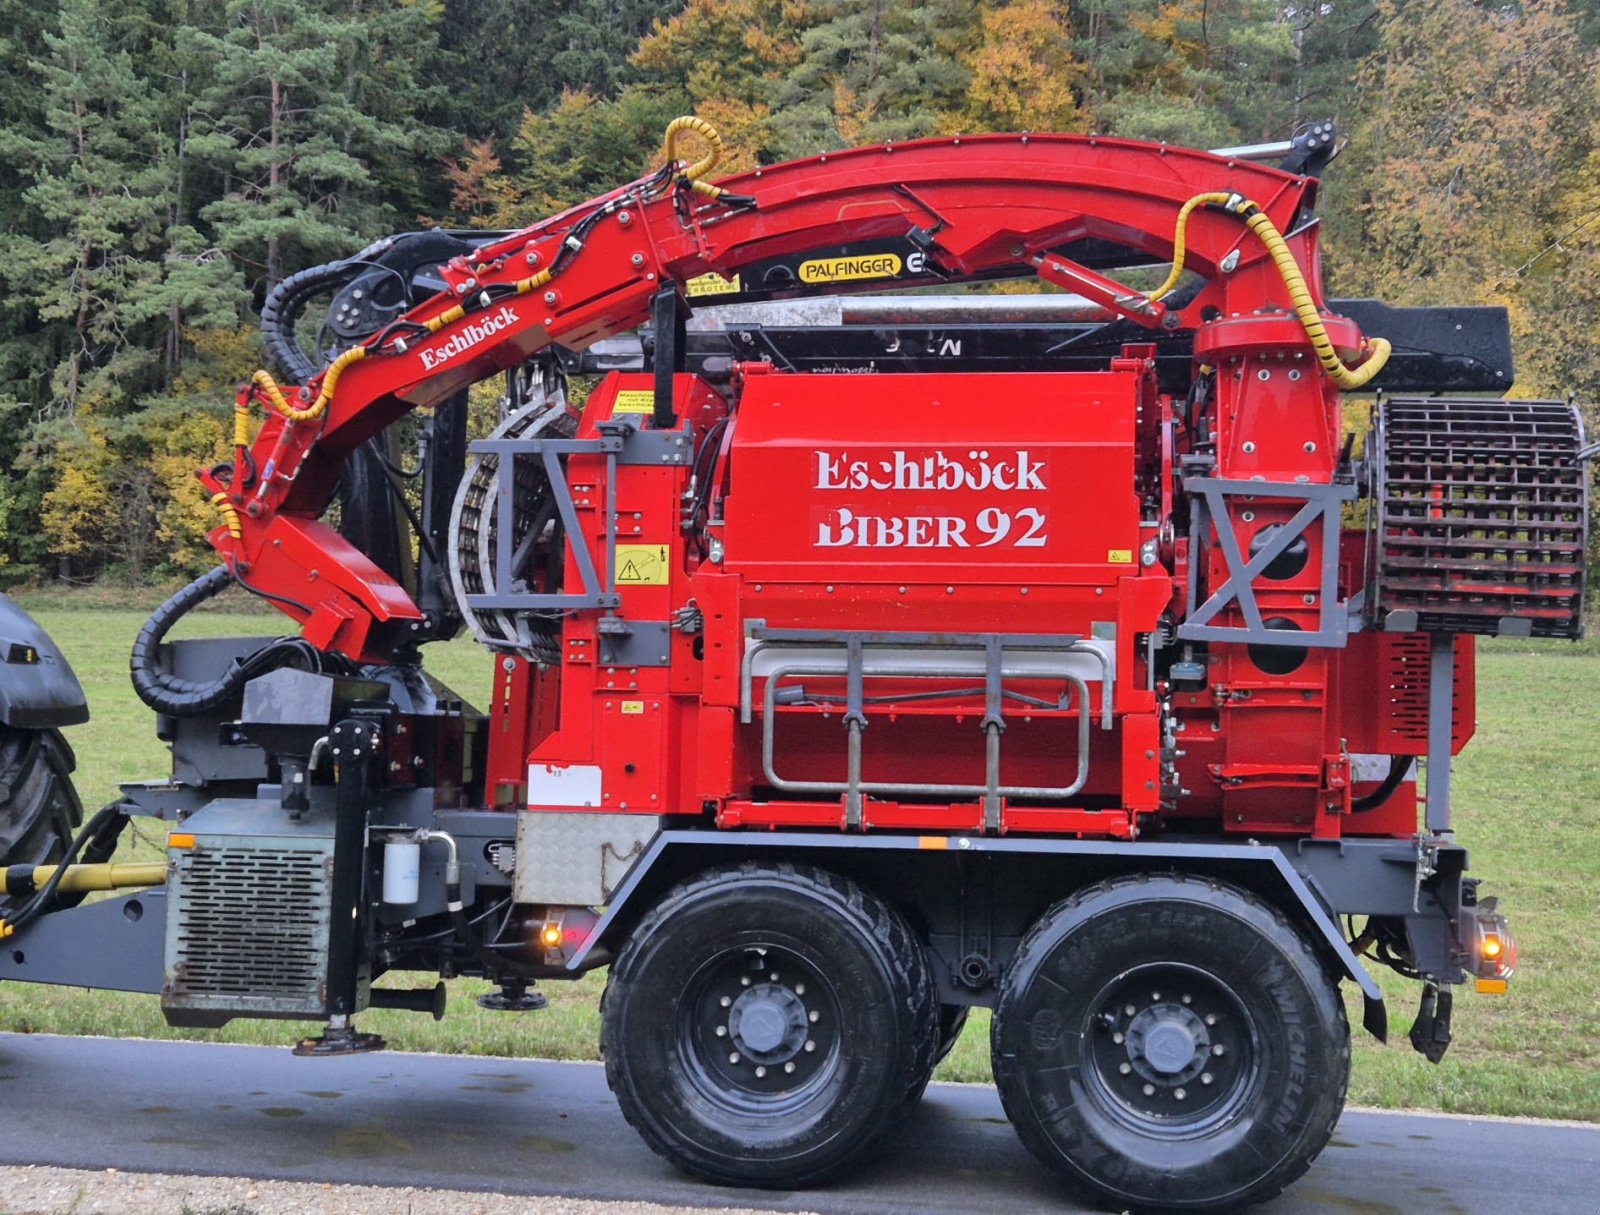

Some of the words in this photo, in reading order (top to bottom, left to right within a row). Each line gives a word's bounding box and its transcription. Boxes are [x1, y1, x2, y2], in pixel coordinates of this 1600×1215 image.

[806, 258, 894, 278] PALFINGER
[418, 306, 520, 372] Eschlböck
[813, 450, 1047, 490] Eschlböck
[813, 507, 970, 547] BIBER
[975, 507, 1047, 547] 92
[1270, 984, 1308, 1134] MICHELIN
